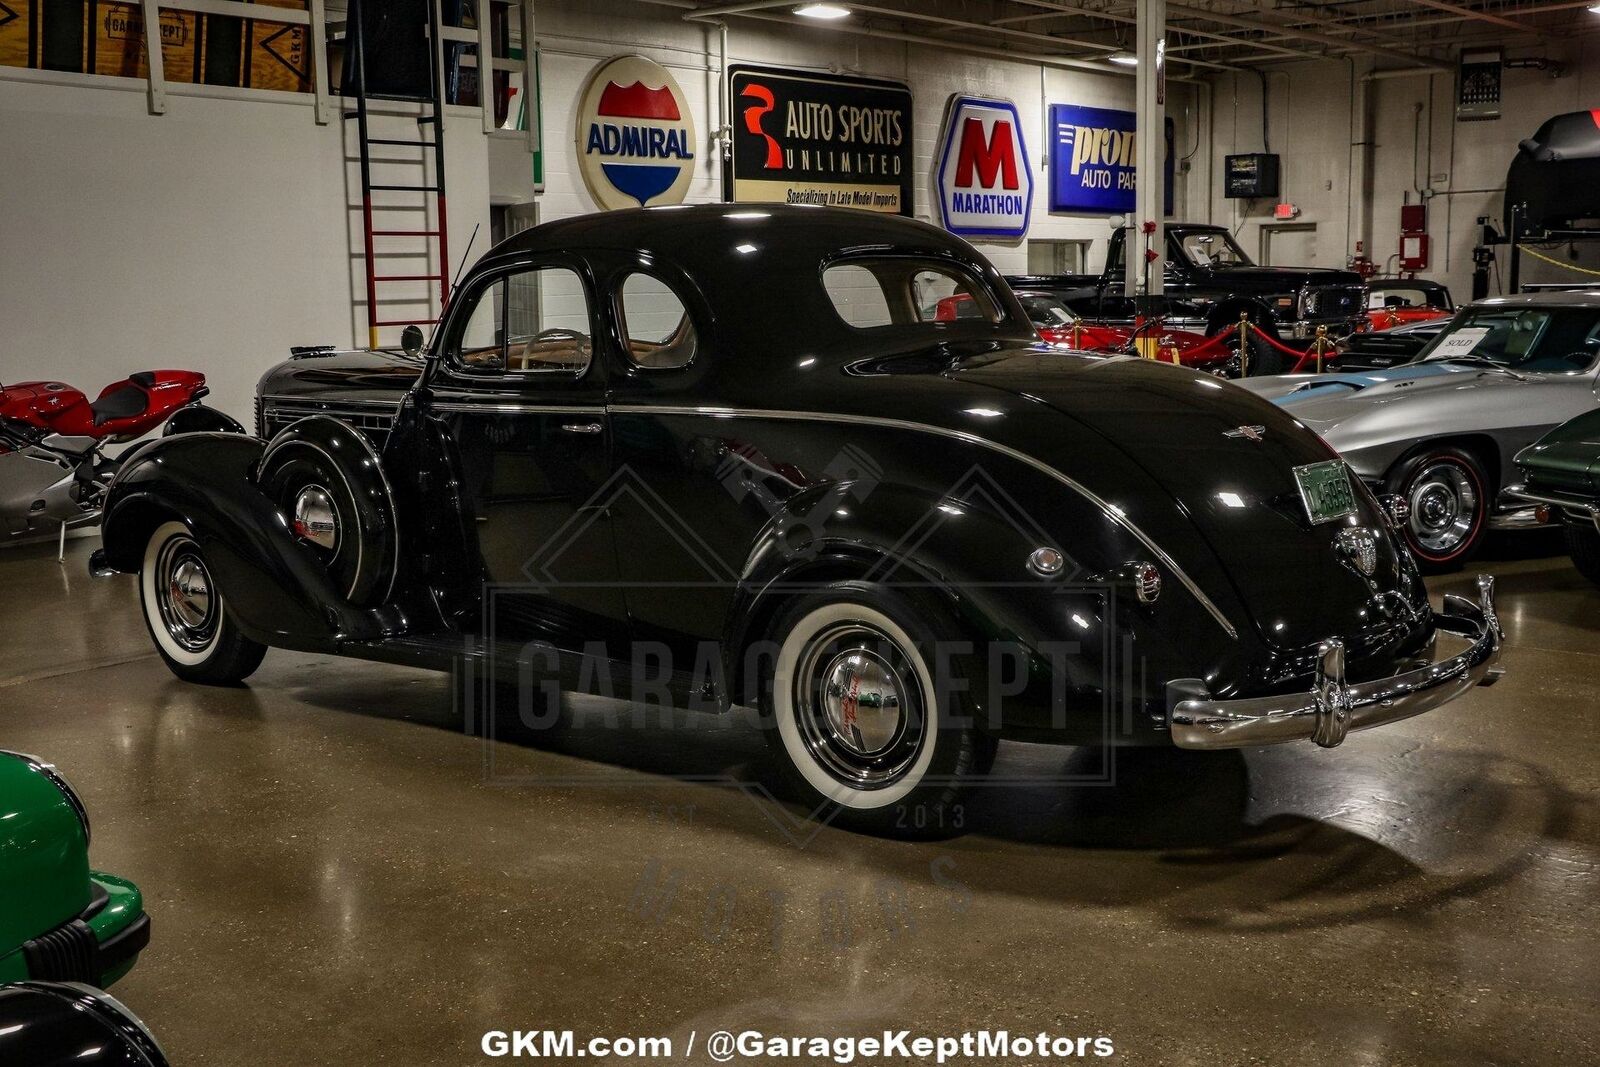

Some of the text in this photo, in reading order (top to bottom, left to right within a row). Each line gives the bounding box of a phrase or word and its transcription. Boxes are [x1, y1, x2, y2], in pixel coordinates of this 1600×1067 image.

[291, 29, 301, 64] GKM
[786, 101, 902, 146] AUTO SPORTS
[586, 123, 694, 159] ADMIRAL
[955, 118, 1019, 190] M
[1071, 126, 1136, 175] pron
[786, 149, 901, 175] UNLIMITED
[1081, 169, 1136, 190] AUTO PAR
[787, 188, 898, 207] Specializing In Late Model Imports
[953, 192, 1022, 215] MARATHON
[1445, 339, 1473, 347] SOLD
